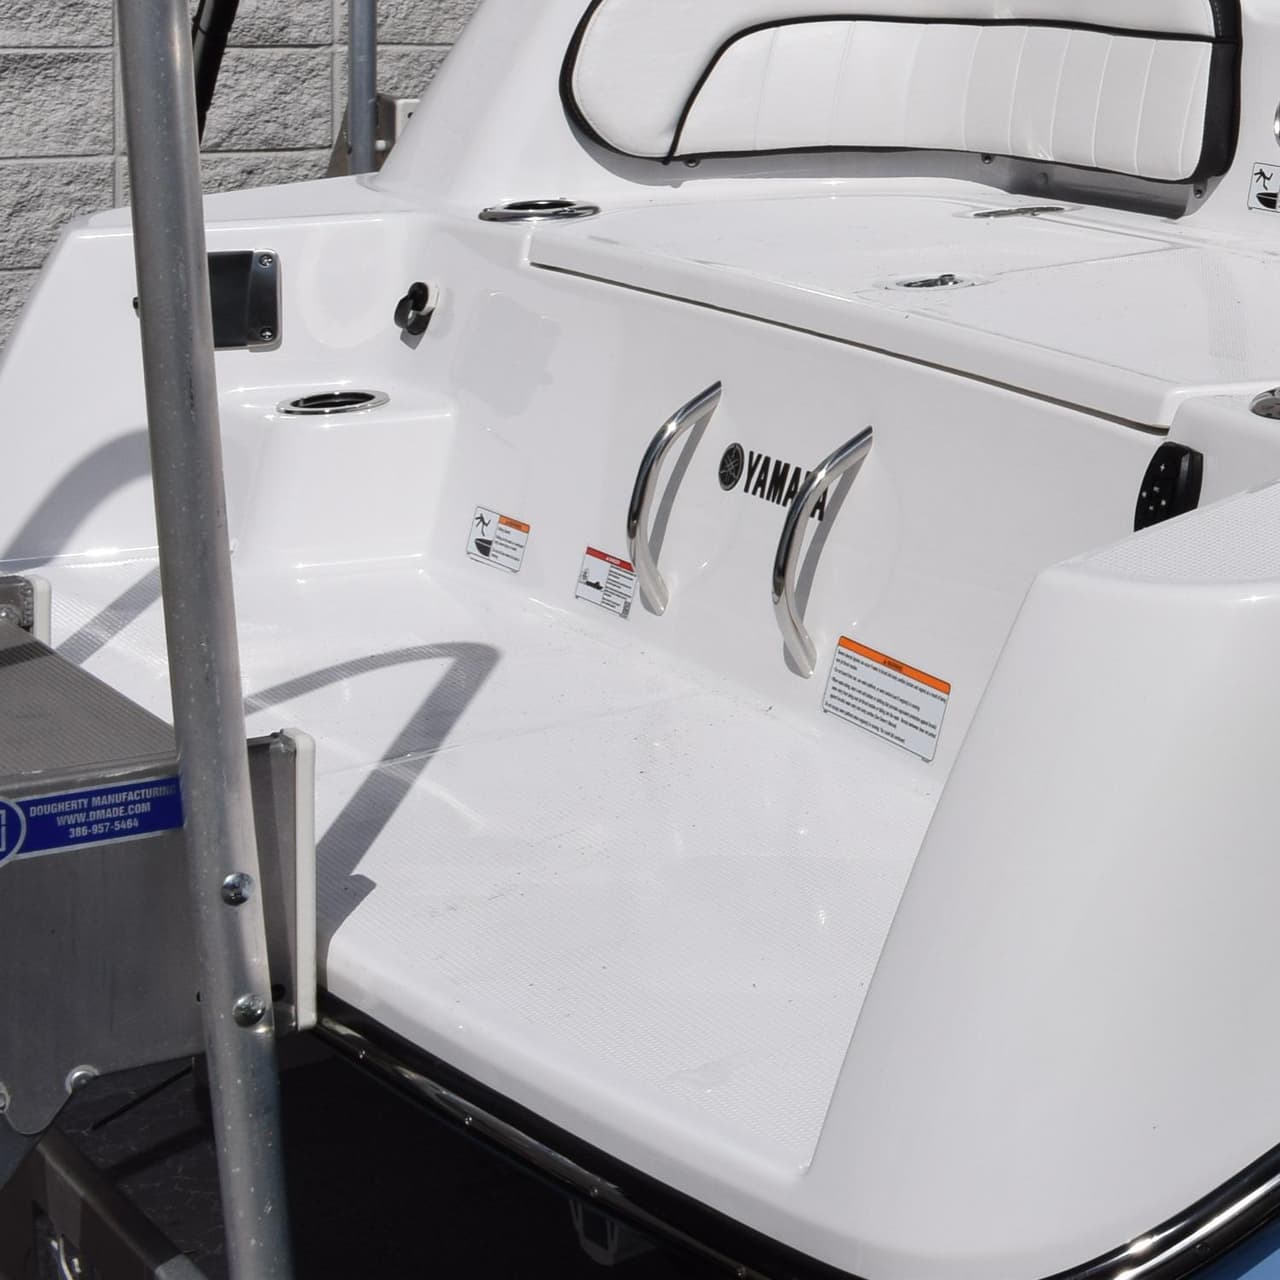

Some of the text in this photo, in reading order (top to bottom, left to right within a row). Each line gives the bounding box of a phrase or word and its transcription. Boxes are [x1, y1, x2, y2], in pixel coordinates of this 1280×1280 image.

[743, 450, 829, 522] YAMAA
[29, 797, 88, 818] DOUGHERTY
[56, 801, 152, 827] WWW.DMADE.COM
